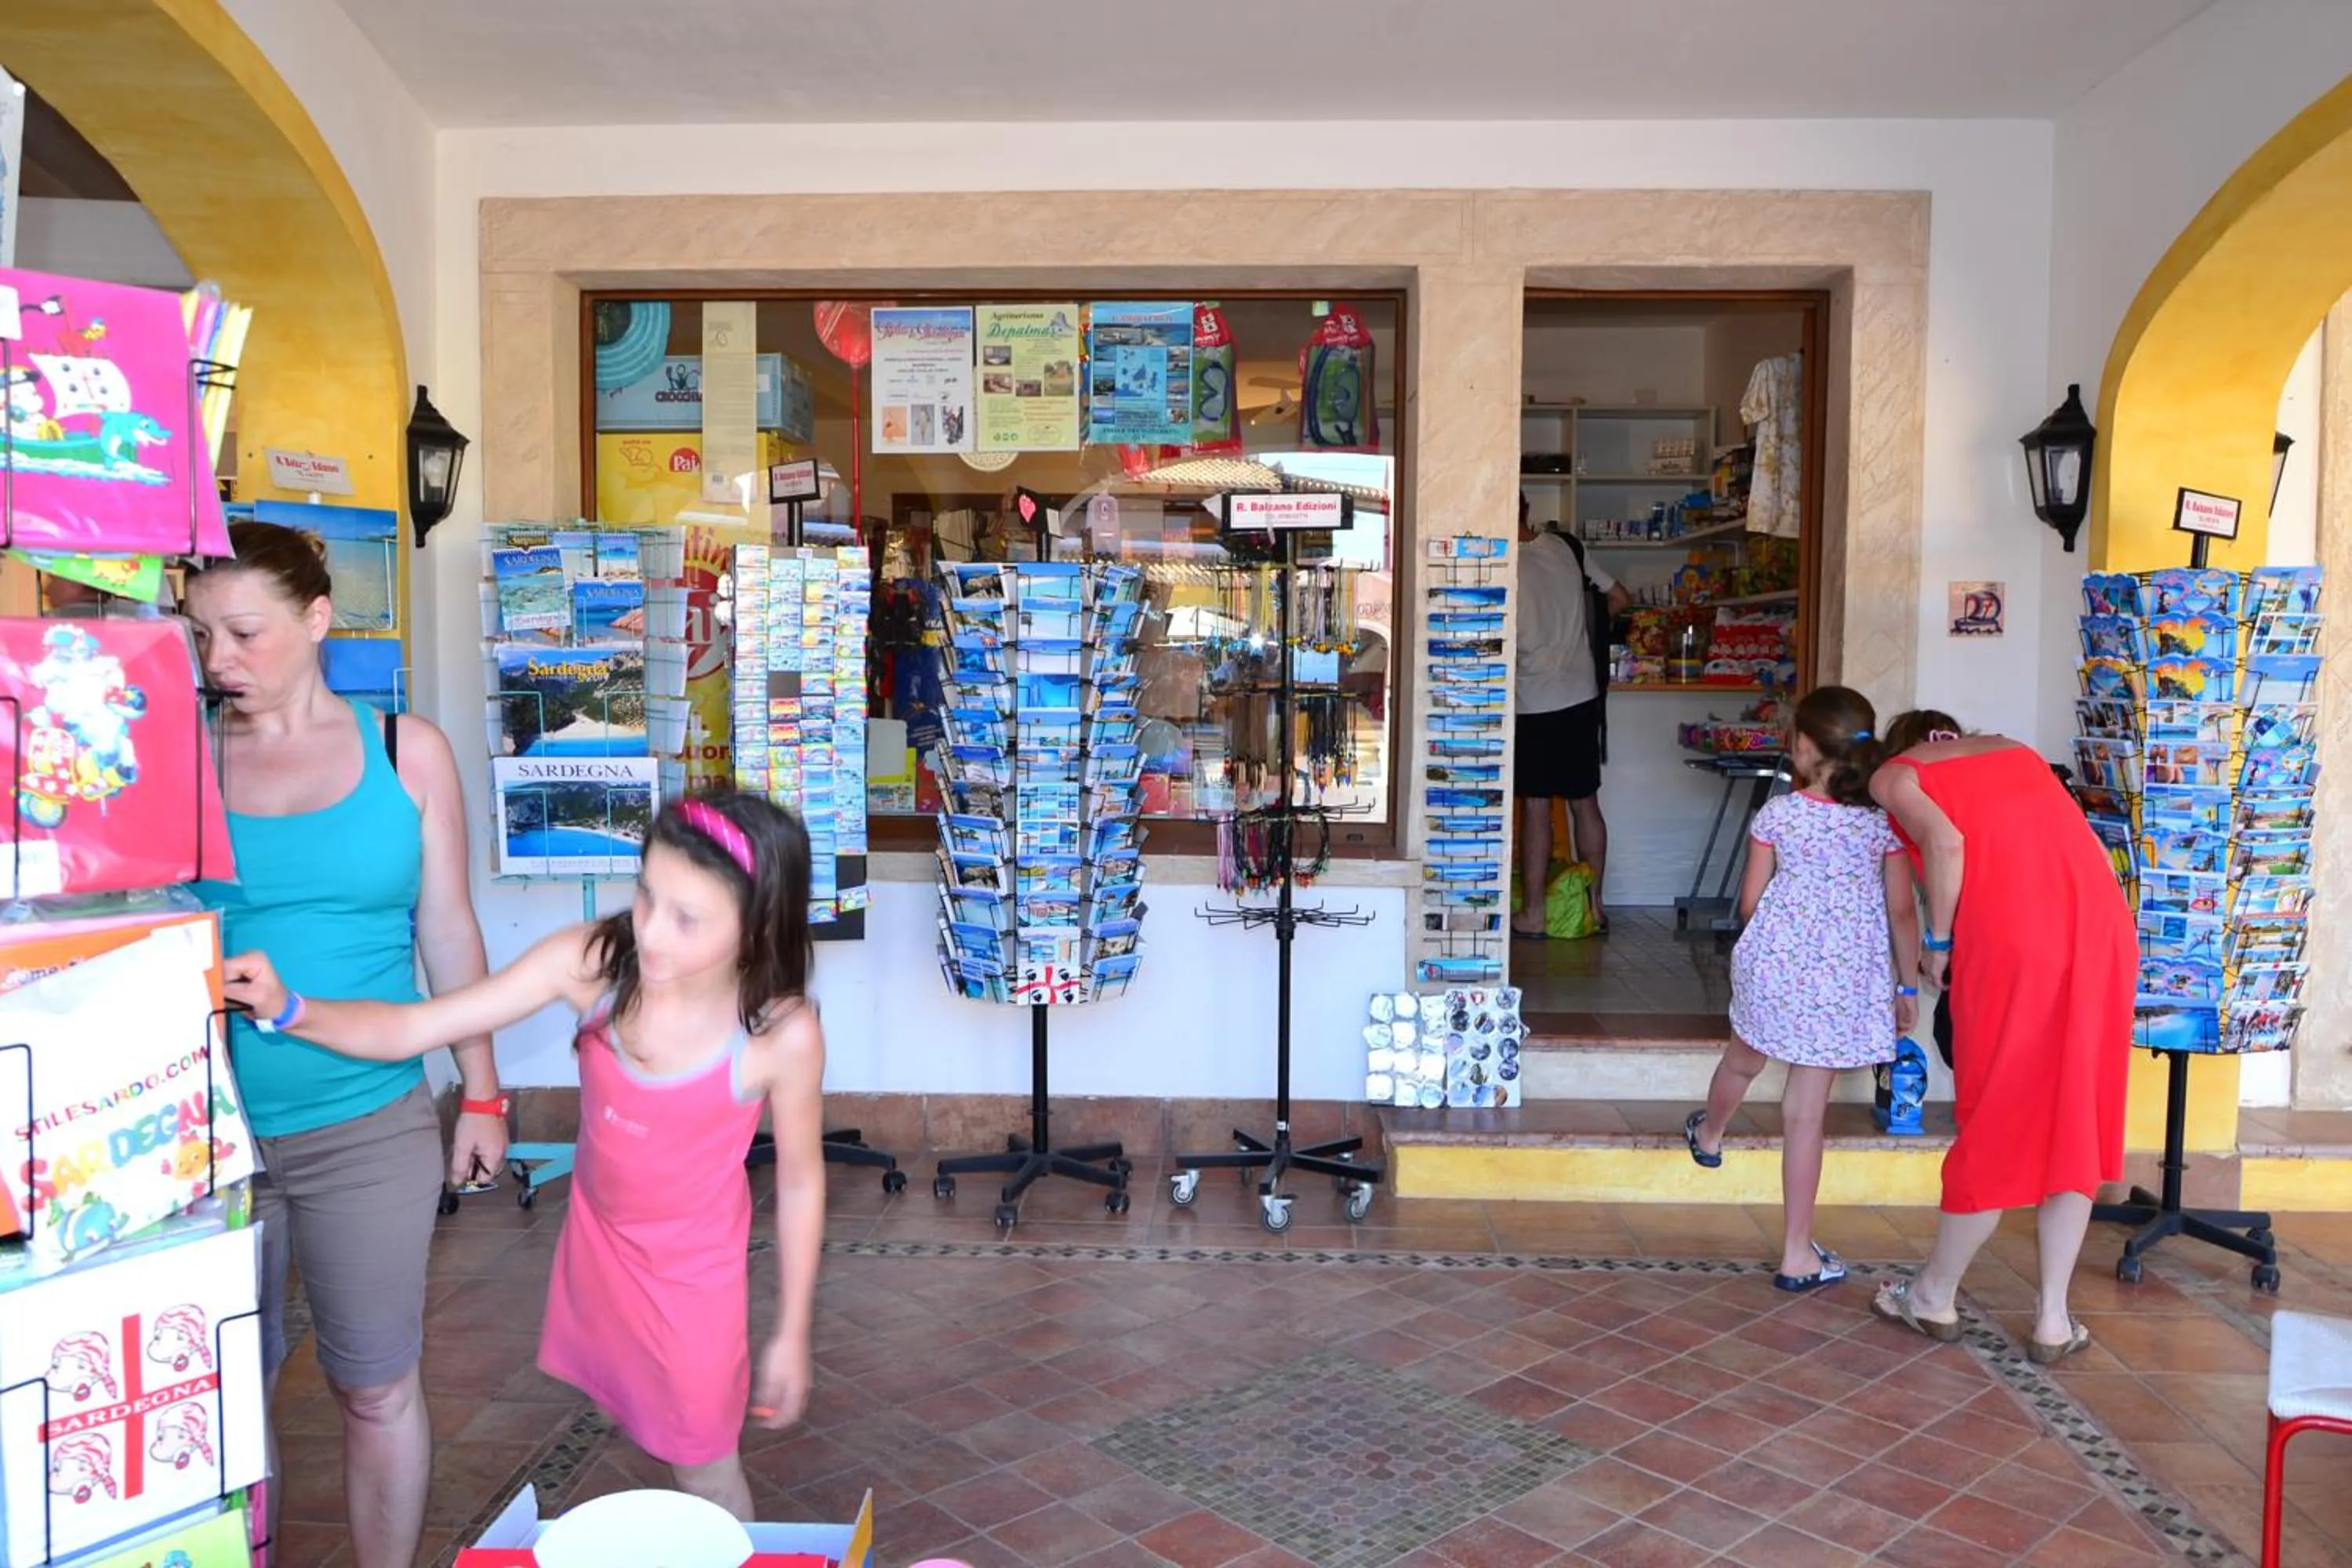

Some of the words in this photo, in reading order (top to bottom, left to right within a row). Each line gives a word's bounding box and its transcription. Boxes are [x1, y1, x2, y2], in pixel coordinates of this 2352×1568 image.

[1236, 503, 1247, 512] R.
[1250, 501, 1294, 512] Balzano
[1296, 500, 1338, 511] Edizioni
[517, 764, 634, 779] SARDEGNA
[14, 1044, 210, 1143] STILESARDO.COM
[20, 1085, 237, 1213] SARDEGNA
[45, 1378, 212, 1435] SARDEGNA
